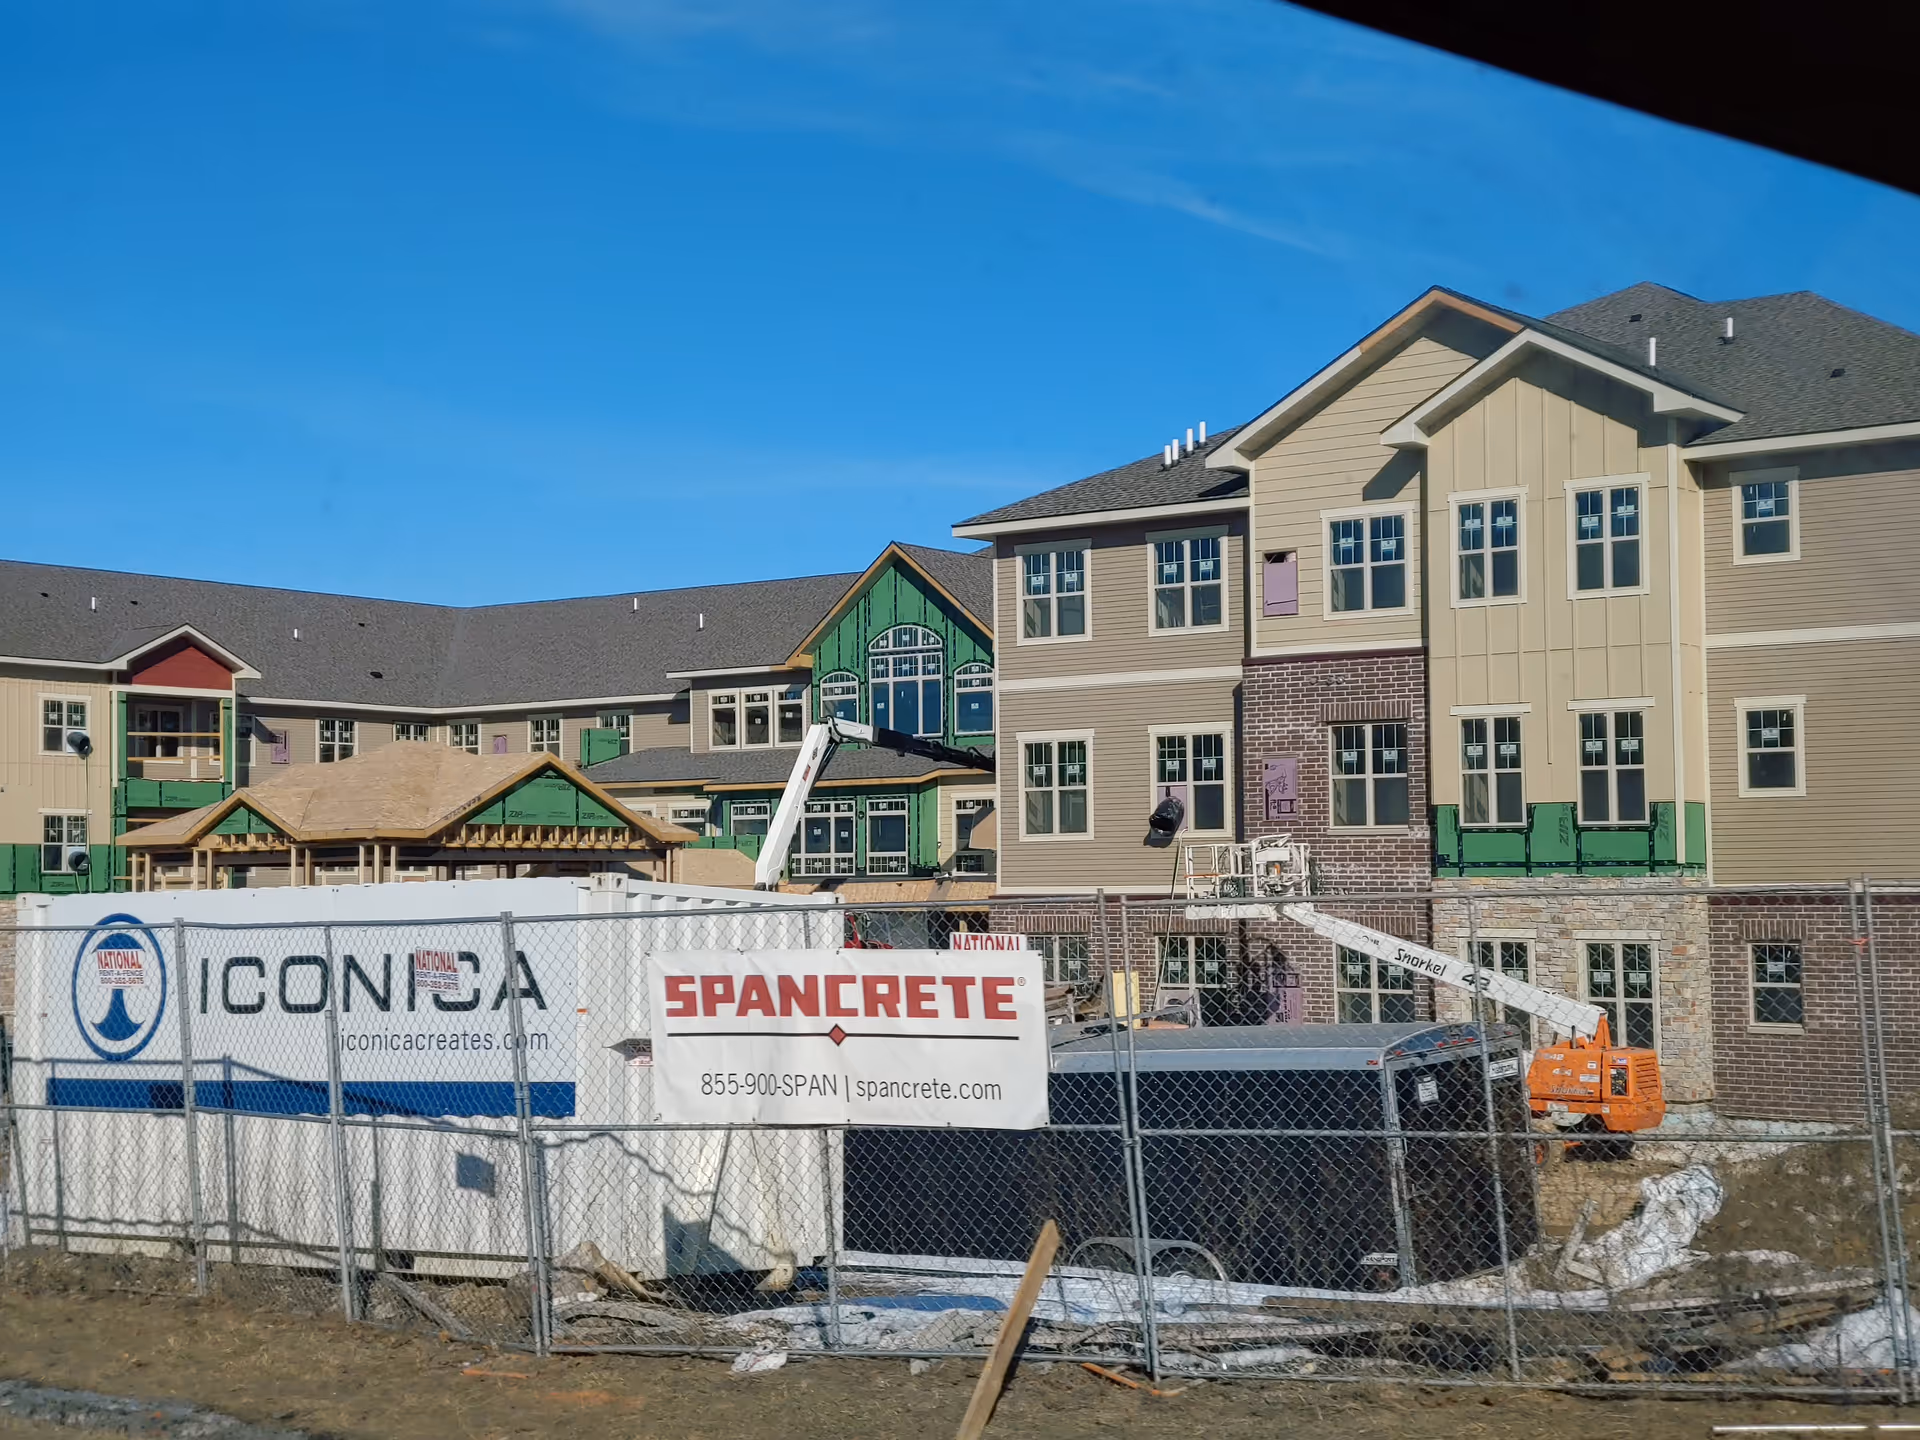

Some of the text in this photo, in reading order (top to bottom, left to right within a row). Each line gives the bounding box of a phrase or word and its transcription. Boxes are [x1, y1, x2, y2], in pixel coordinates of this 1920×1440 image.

[97, 950, 142, 969] NATIONAL
[415, 949, 458, 973] NATIONAL
[1394, 948, 1447, 977] Snorkel
[200, 950, 548, 1014] ICONICA
[664, 974, 1018, 1020] SPANCRETE
[341, 1028, 548, 1051] iconicacreates.com
[701, 1072, 1002, 1102] 855-900-SPAN spancrete.com
